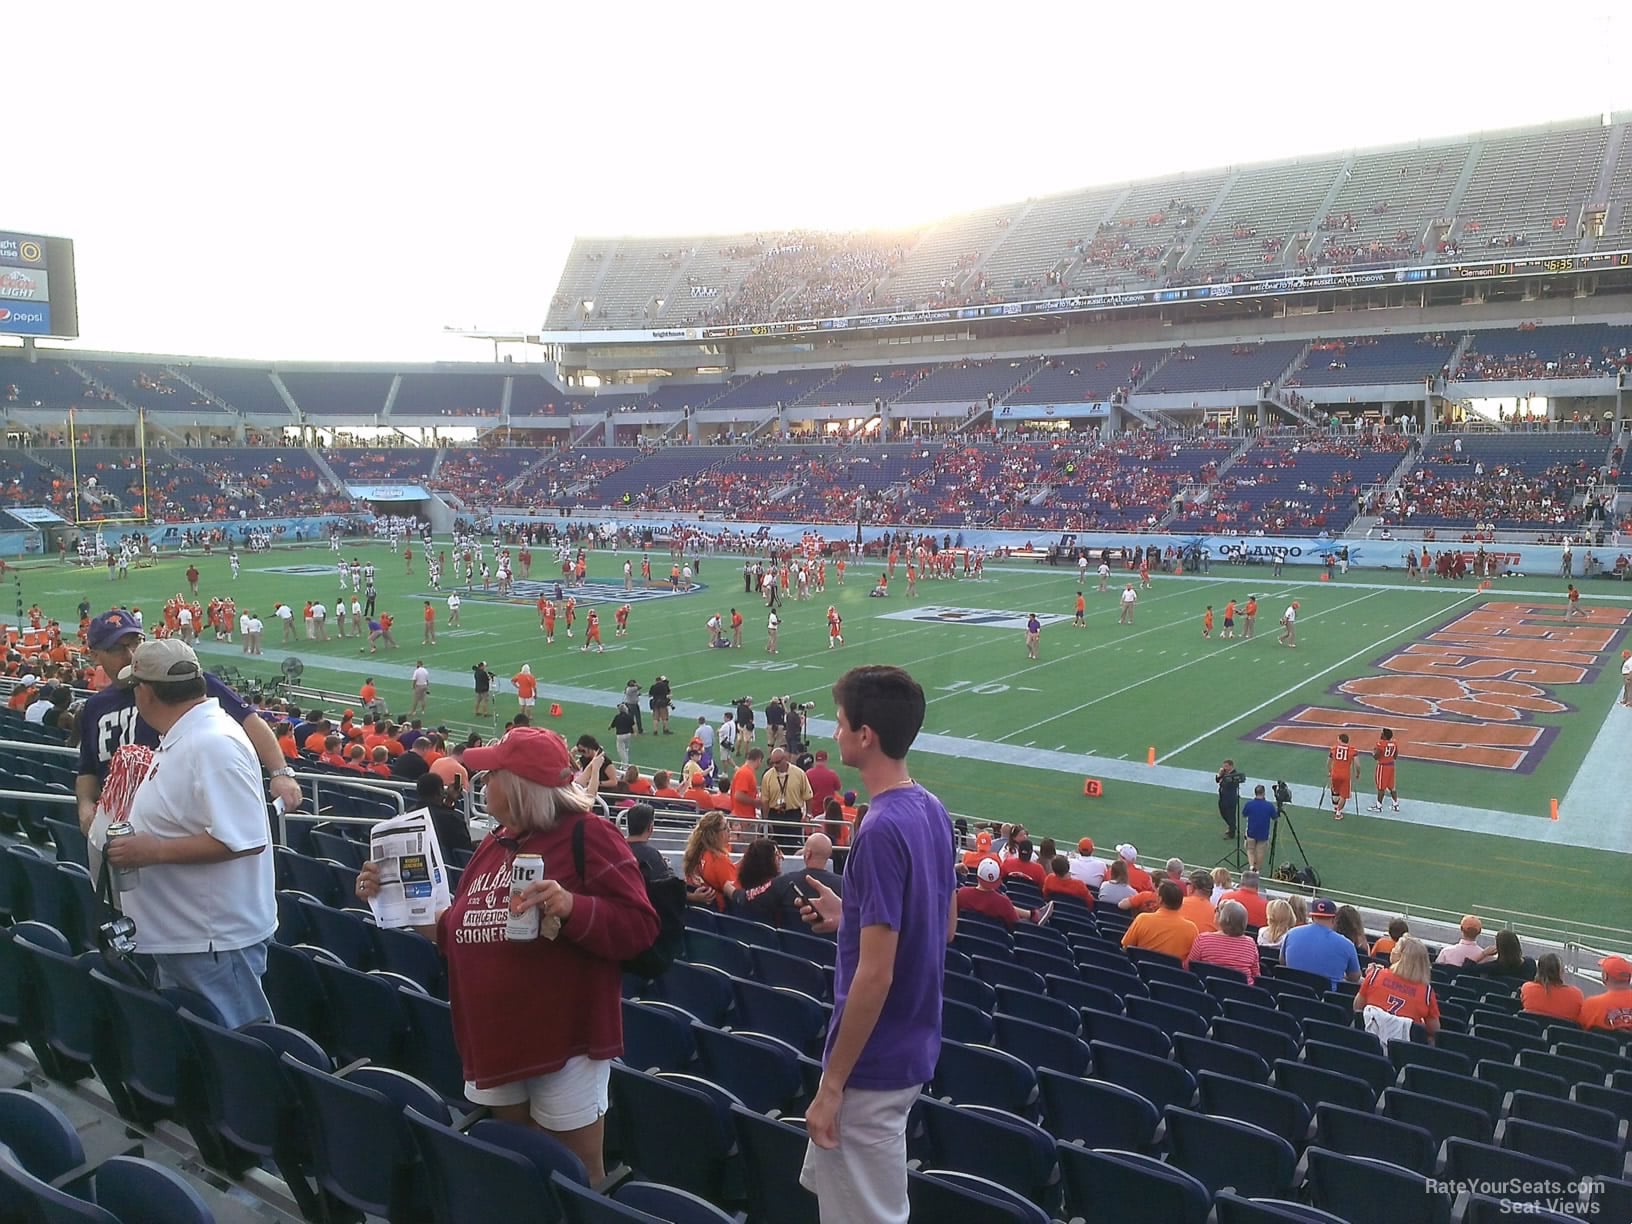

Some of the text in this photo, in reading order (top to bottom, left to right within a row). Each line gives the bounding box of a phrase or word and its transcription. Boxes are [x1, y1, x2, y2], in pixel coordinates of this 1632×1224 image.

[1544, 260, 1572, 271] 46:35
[1620, 255, 1628, 265] 0
[1461, 269, 1493, 277] Clemson
[1500, 264, 1506, 274] 0
[2, 287, 34, 297] LIGHT
[13, 312, 43, 323] pepsi
[1462, 551, 1521, 565] EPN
[934, 680, 1010, 694] 10
[1336, 746, 1347, 760] 81
[1385, 746, 1396, 757] 87
[1087, 781, 1098, 794] G
[511, 865, 535, 883] ite
[465, 911, 508, 925] ATHLETICS
[1386, 994, 1406, 1015] 7
